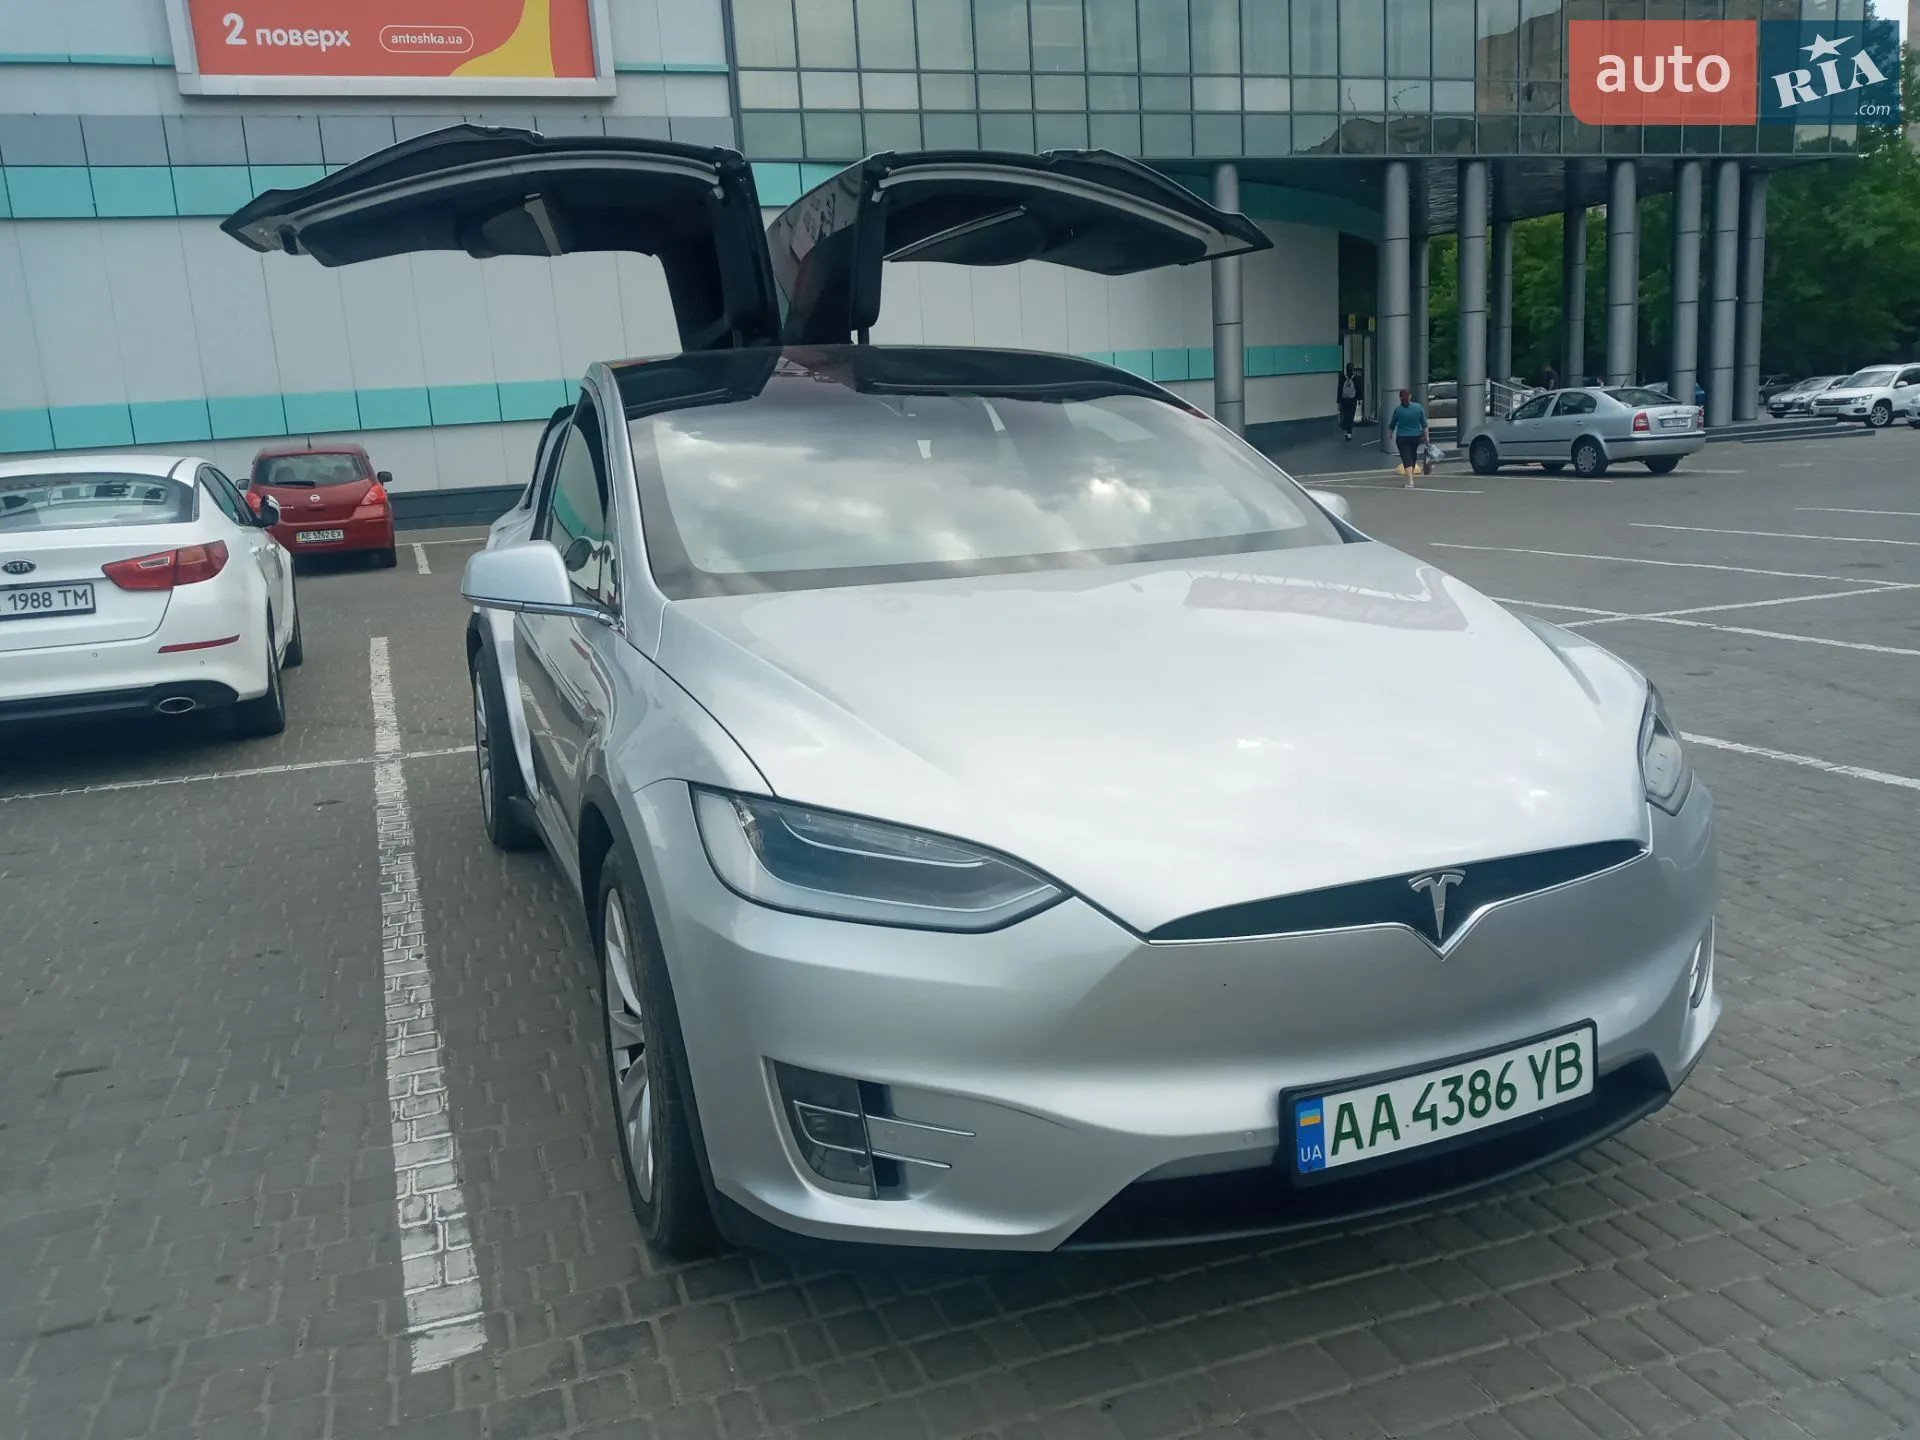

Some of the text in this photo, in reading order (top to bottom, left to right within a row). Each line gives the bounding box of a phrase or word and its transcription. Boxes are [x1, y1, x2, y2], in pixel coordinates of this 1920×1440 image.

[222, 12, 352, 52] 2 поверх
[391, 32, 463, 46] antoshka.ua
[7, 562, 31, 573] KIA
[8, 588, 89, 611] 1988 TM
[1330, 1041, 1584, 1157] AA 4386 YB
[1300, 1144, 1323, 1163] UA
